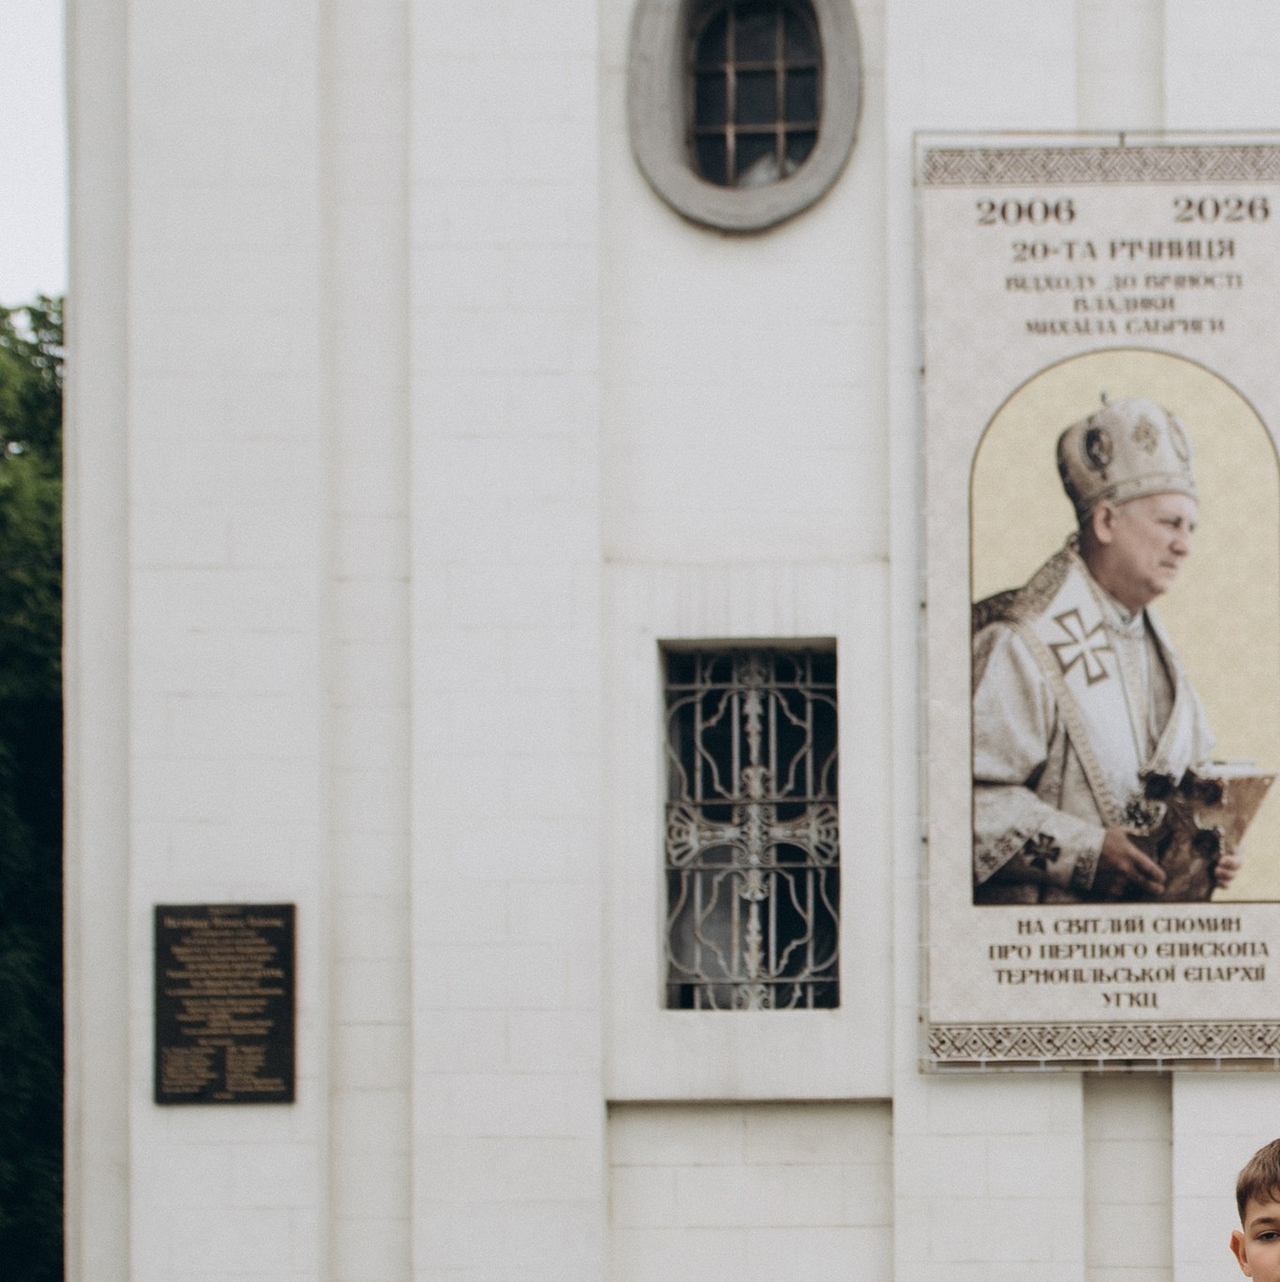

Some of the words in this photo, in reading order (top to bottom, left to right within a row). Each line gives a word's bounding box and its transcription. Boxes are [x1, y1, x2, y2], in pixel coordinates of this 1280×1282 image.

[976, 198, 1077, 226] 2006
[1173, 197, 1271, 224] 2026
[1012, 239, 1097, 263] 20-ТА
[1109, 238, 1236, 262] РІЧНИЦЯ
[1017, 919, 1045, 935] НА
[1054, 916, 1144, 935] СВІТЛИЙ
[1153, 917, 1241, 934] СПОМИН
[988, 943, 1032, 960] ПРО
[1039, 942, 1148, 960] ПЕРШОГО
[1155, 940, 1270, 959] ЄПИСКОПА
[995, 963, 1176, 985] ТЕРНОПІЛЬСЬКОЇ
[1183, 962, 1266, 983] ЄПАРХІЇ
[1100, 991, 1160, 1010] УГКЦ
